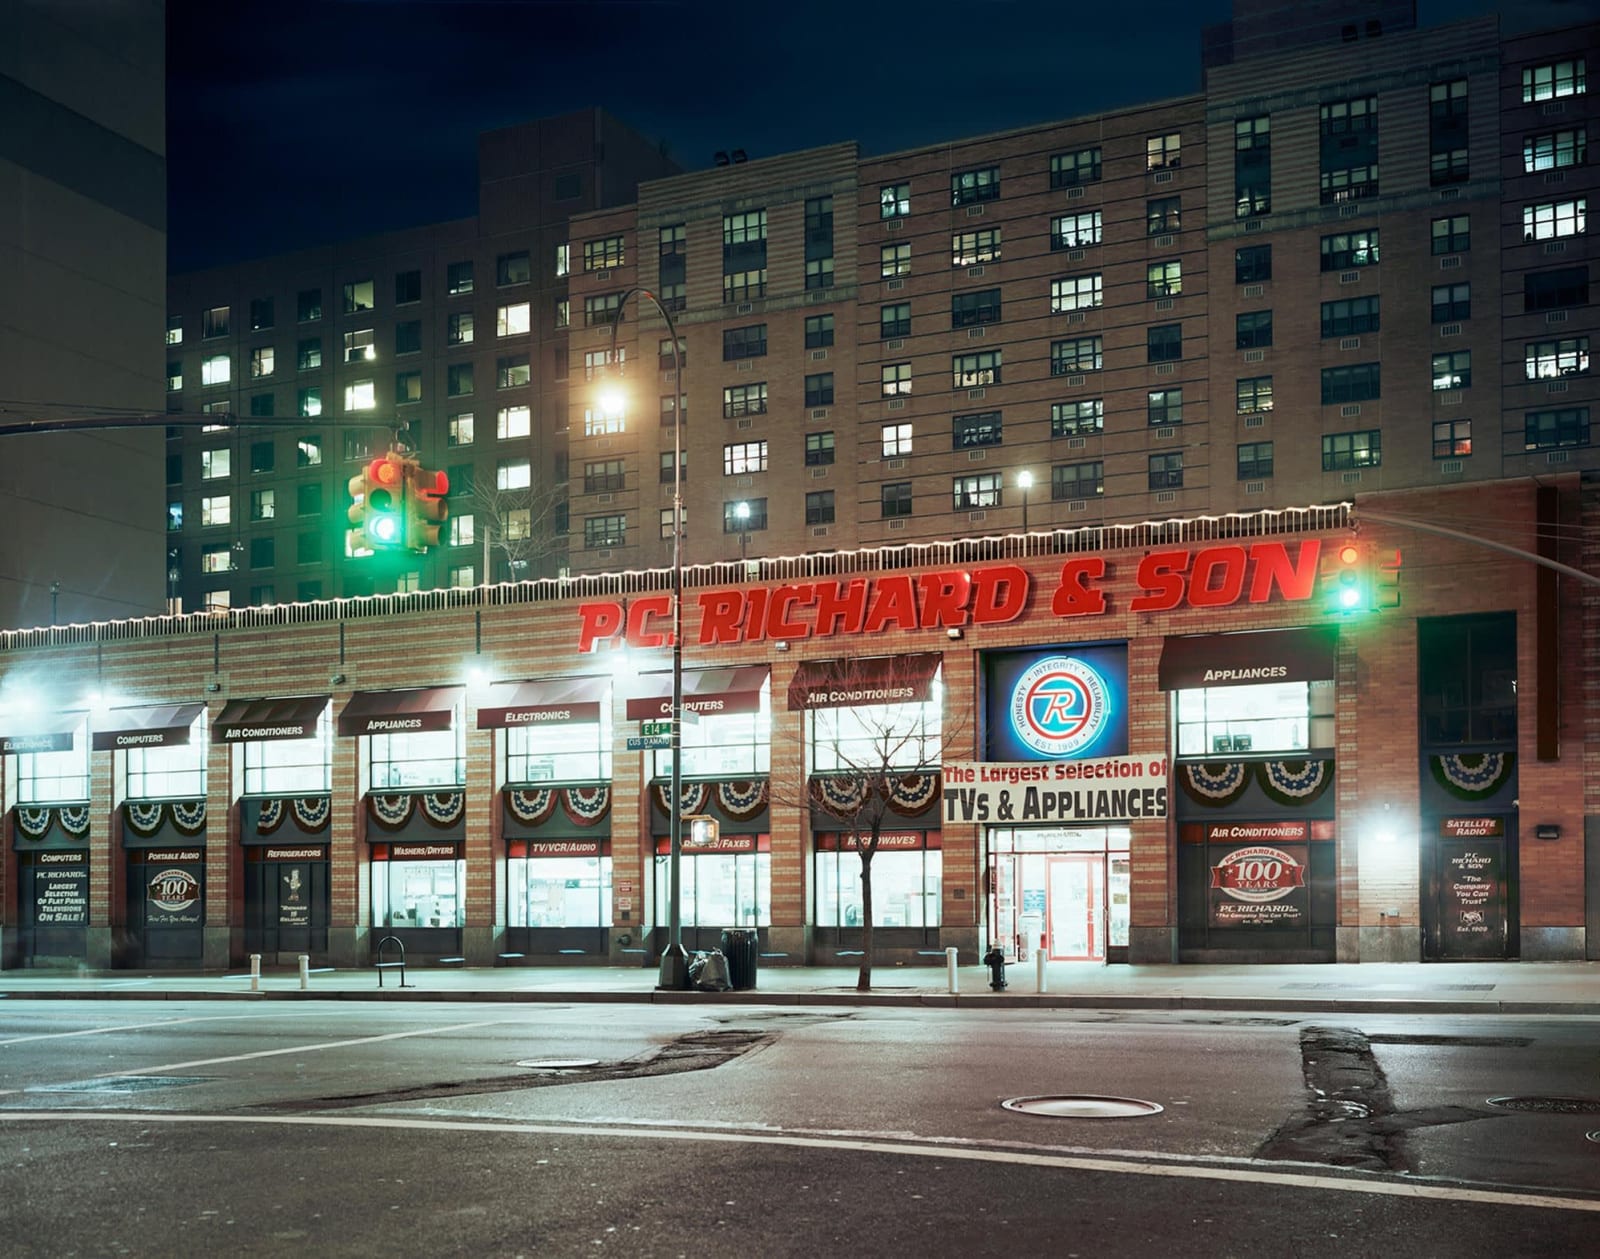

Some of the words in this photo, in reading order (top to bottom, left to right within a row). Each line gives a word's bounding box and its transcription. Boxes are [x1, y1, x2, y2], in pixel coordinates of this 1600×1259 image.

[698, 566, 1029, 645] RICHARD
[1052, 557, 1106, 617] &
[1130, 539, 1321, 612] SON
[1034, 662, 1080, 676] INTEGRITY
[1204, 666, 1288, 681] APPLIANCES
[806, 692, 828, 704] AIR
[830, 688, 914, 701] CONDITIONERS
[660, 700, 724, 713] COPUTERS
[1016, 685, 1026, 728] HONESTY
[1087, 676, 1102, 730] RELIABILITY
[505, 710, 570, 722] ELECTRONICS
[367, 719, 422, 730] APPLIANCES
[644, 726, 649, 735] E
[652, 724, 660, 734] 14
[225, 729, 241, 738] AIR
[242, 726, 303, 737] CONDITIONERS
[116, 734, 163, 745] COMPUTERS
[944, 766, 975, 784] The
[981, 764, 1050, 784] Largest
[1055, 760, 1143, 780] Selection
[1149, 758, 1167, 776] of
[997, 790, 1014, 820] &
[1022, 786, 1167, 820] APPLIANCES
[1447, 820, 1496, 828] SATELLITE
[1210, 828, 1229, 838] AIR
[1230, 827, 1304, 838] CONDITIONERS
[848, 835, 916, 846] MCWAVES
[394, 846, 454, 855] WASHERS/DRYERS
[532, 842, 596, 852] TV/VCR/AUDIO
[1236, 848, 1269, 858] RICHARD
[267, 849, 321, 858] REFRIGERATORS
[1235, 861, 1282, 880] 100
[160, 880, 188, 895] 100
[39, 913, 54, 921] ON
